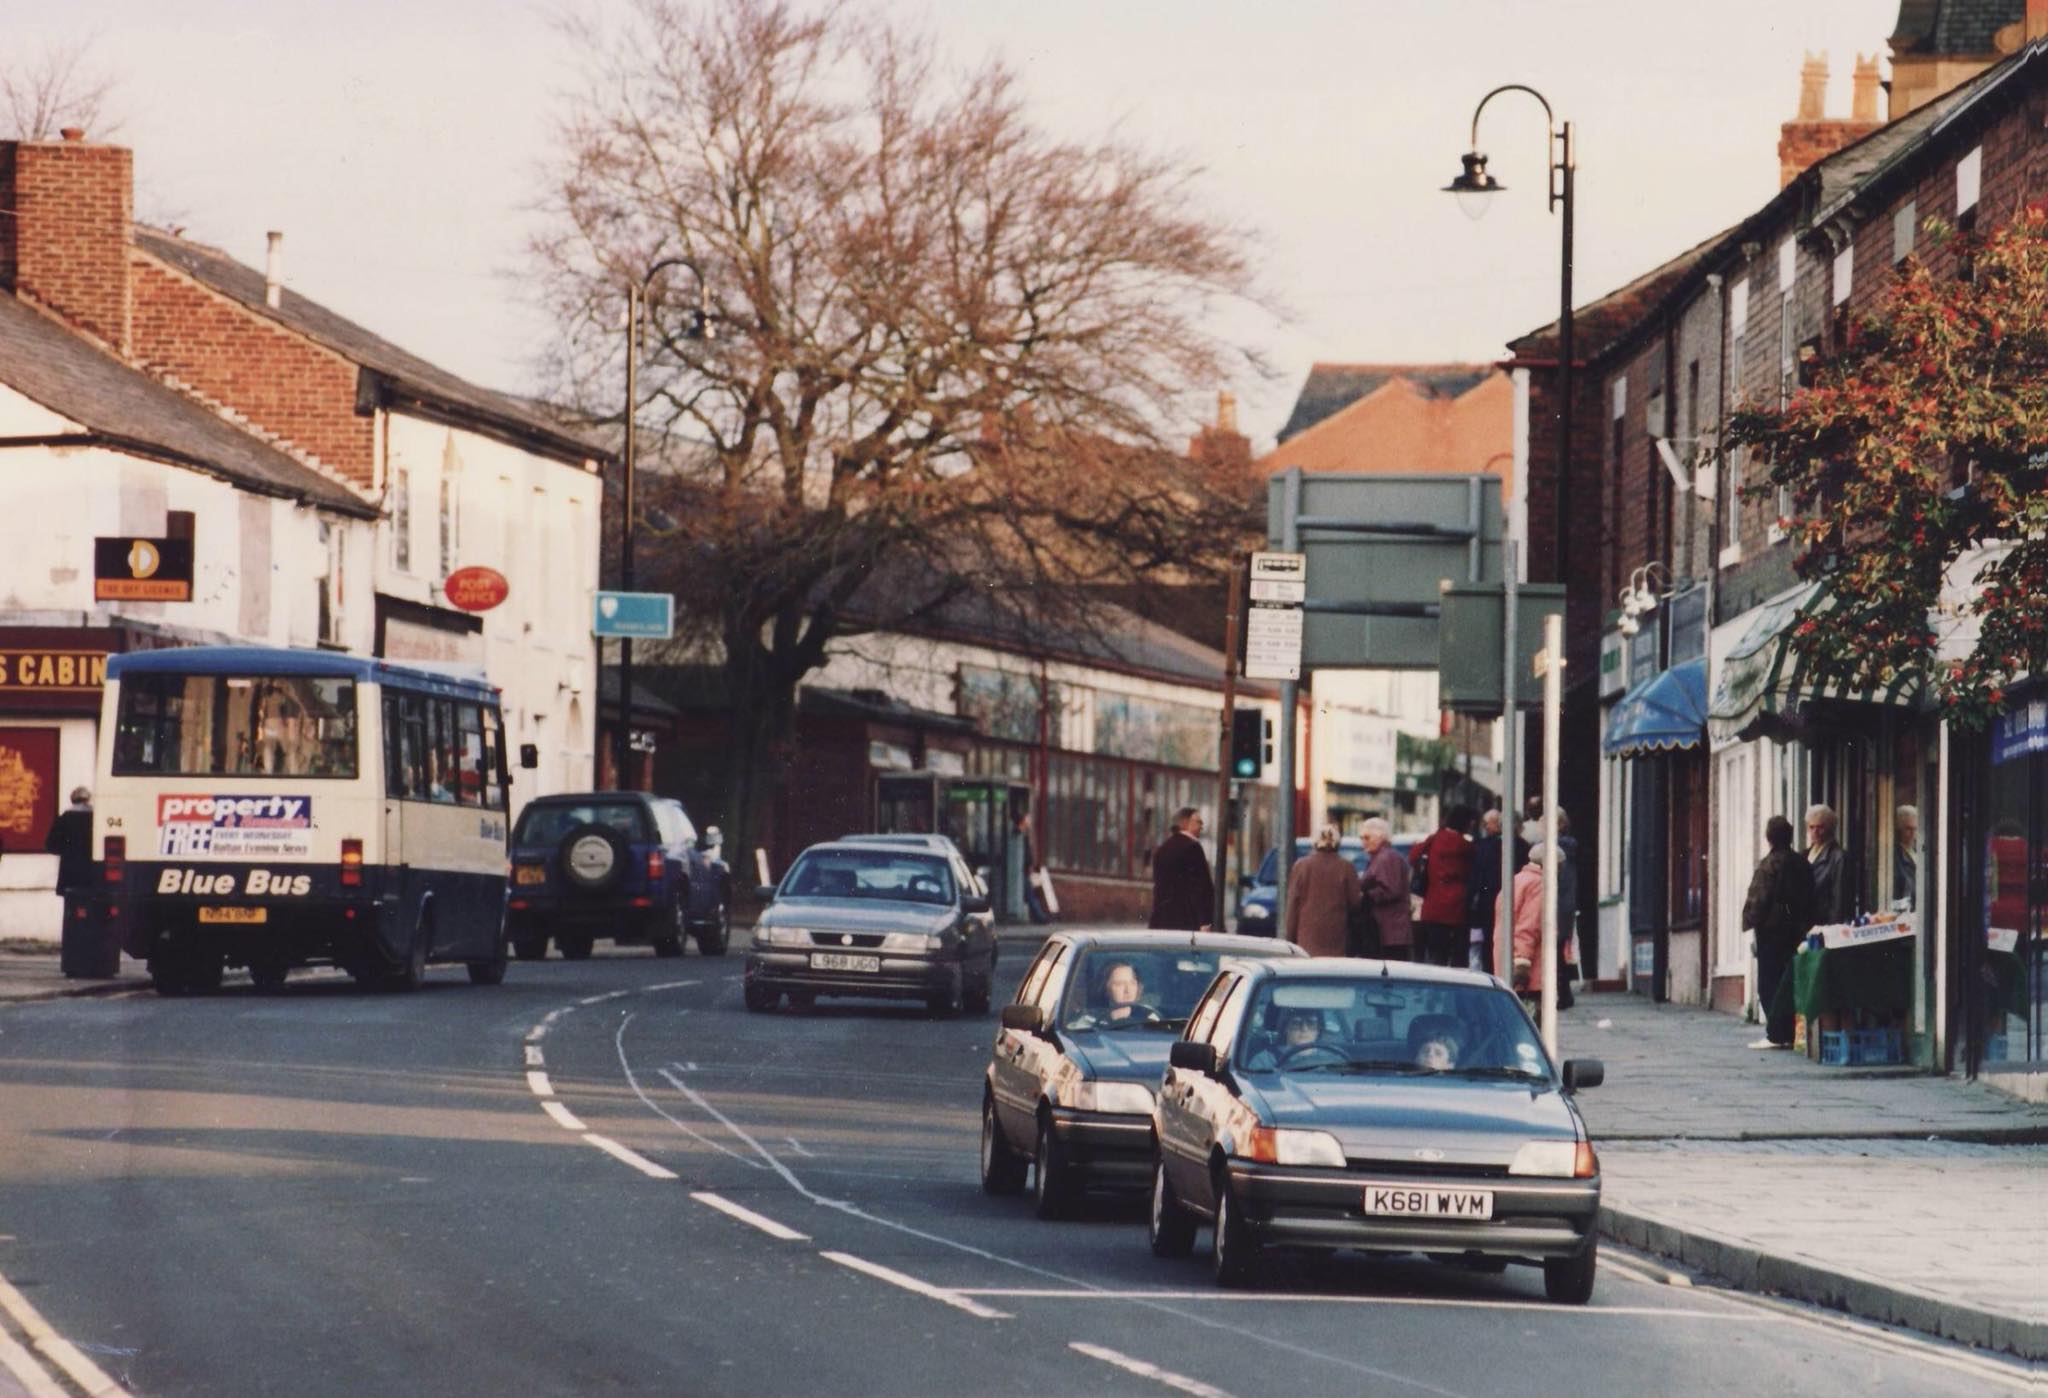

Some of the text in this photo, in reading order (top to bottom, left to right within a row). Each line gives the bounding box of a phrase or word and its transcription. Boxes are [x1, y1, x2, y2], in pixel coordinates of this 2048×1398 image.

[459, 578, 490, 590] POST
[454, 591, 497, 603] OFFICE
[18, 655, 106, 685] CABIN
[163, 796, 304, 822] property
[106, 816, 122, 828] 94
[160, 822, 213, 855] FREE
[245, 843, 280, 855] Evening
[282, 844, 308, 855] News
[157, 869, 312, 896] Blue Bus
[1374, 1190, 1484, 1214] K681 WVM
